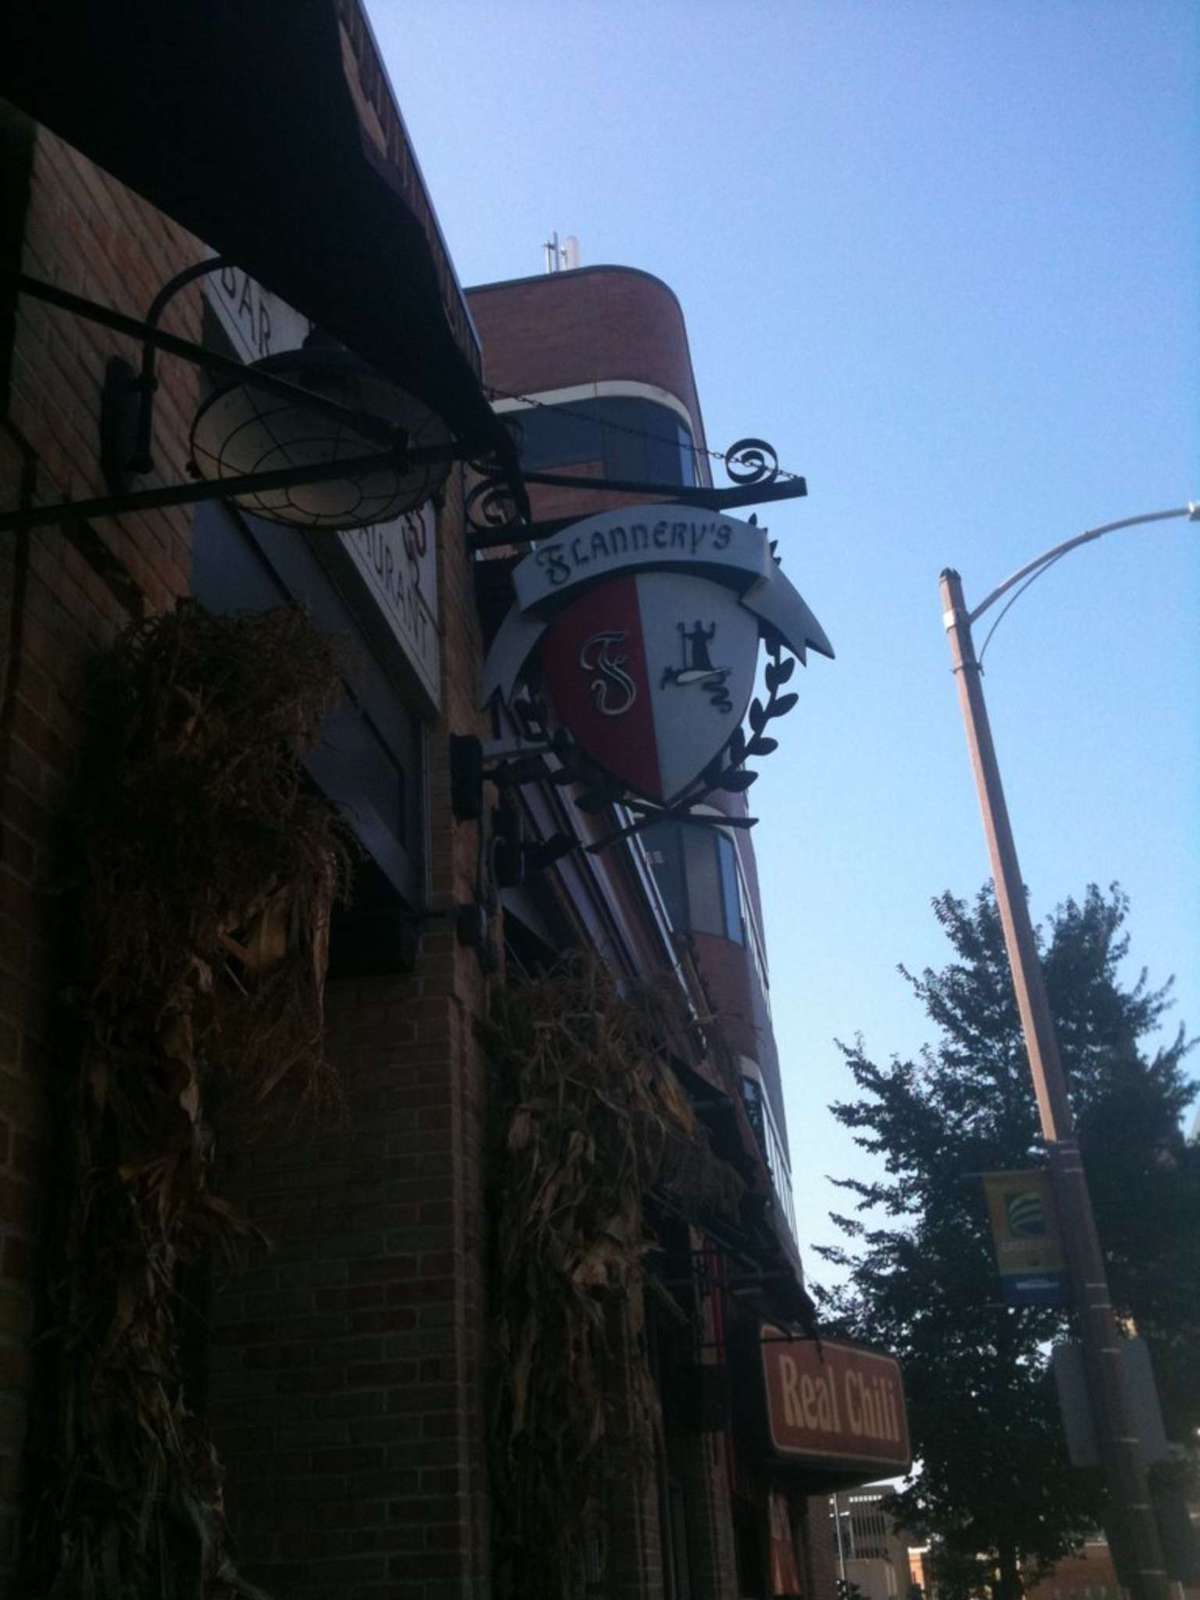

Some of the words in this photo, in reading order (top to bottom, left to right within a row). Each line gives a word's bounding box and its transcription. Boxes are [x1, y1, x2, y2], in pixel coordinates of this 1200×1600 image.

[535, 520, 733, 585] FLANNERY'S
[778, 1353, 842, 1433] Real
[845, 1367, 900, 1442] Chili
